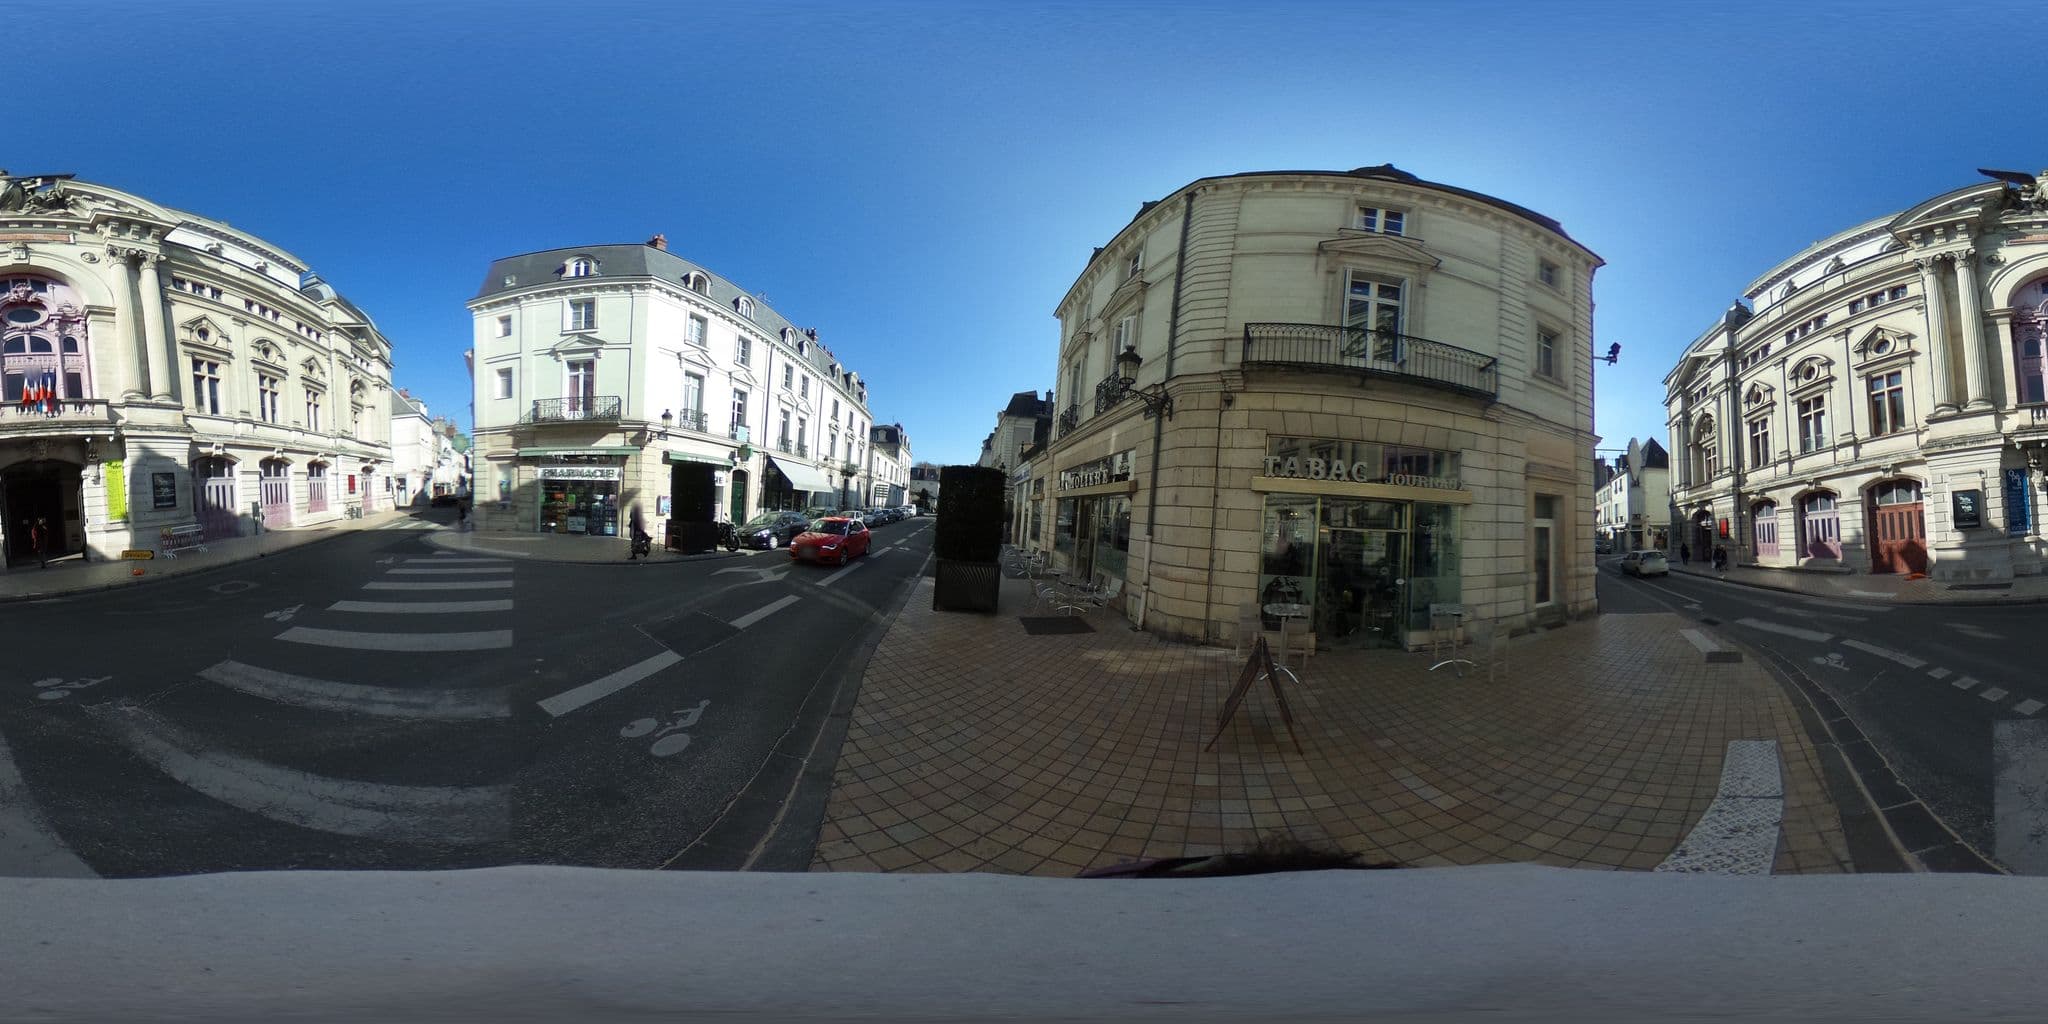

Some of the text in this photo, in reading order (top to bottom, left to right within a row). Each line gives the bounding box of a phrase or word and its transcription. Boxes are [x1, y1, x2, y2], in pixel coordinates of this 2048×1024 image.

[543, 468, 615, 478] PHARMACIE
[1264, 455, 1369, 482] TABAC
[1385, 472, 1465, 491] JOURNAUX
